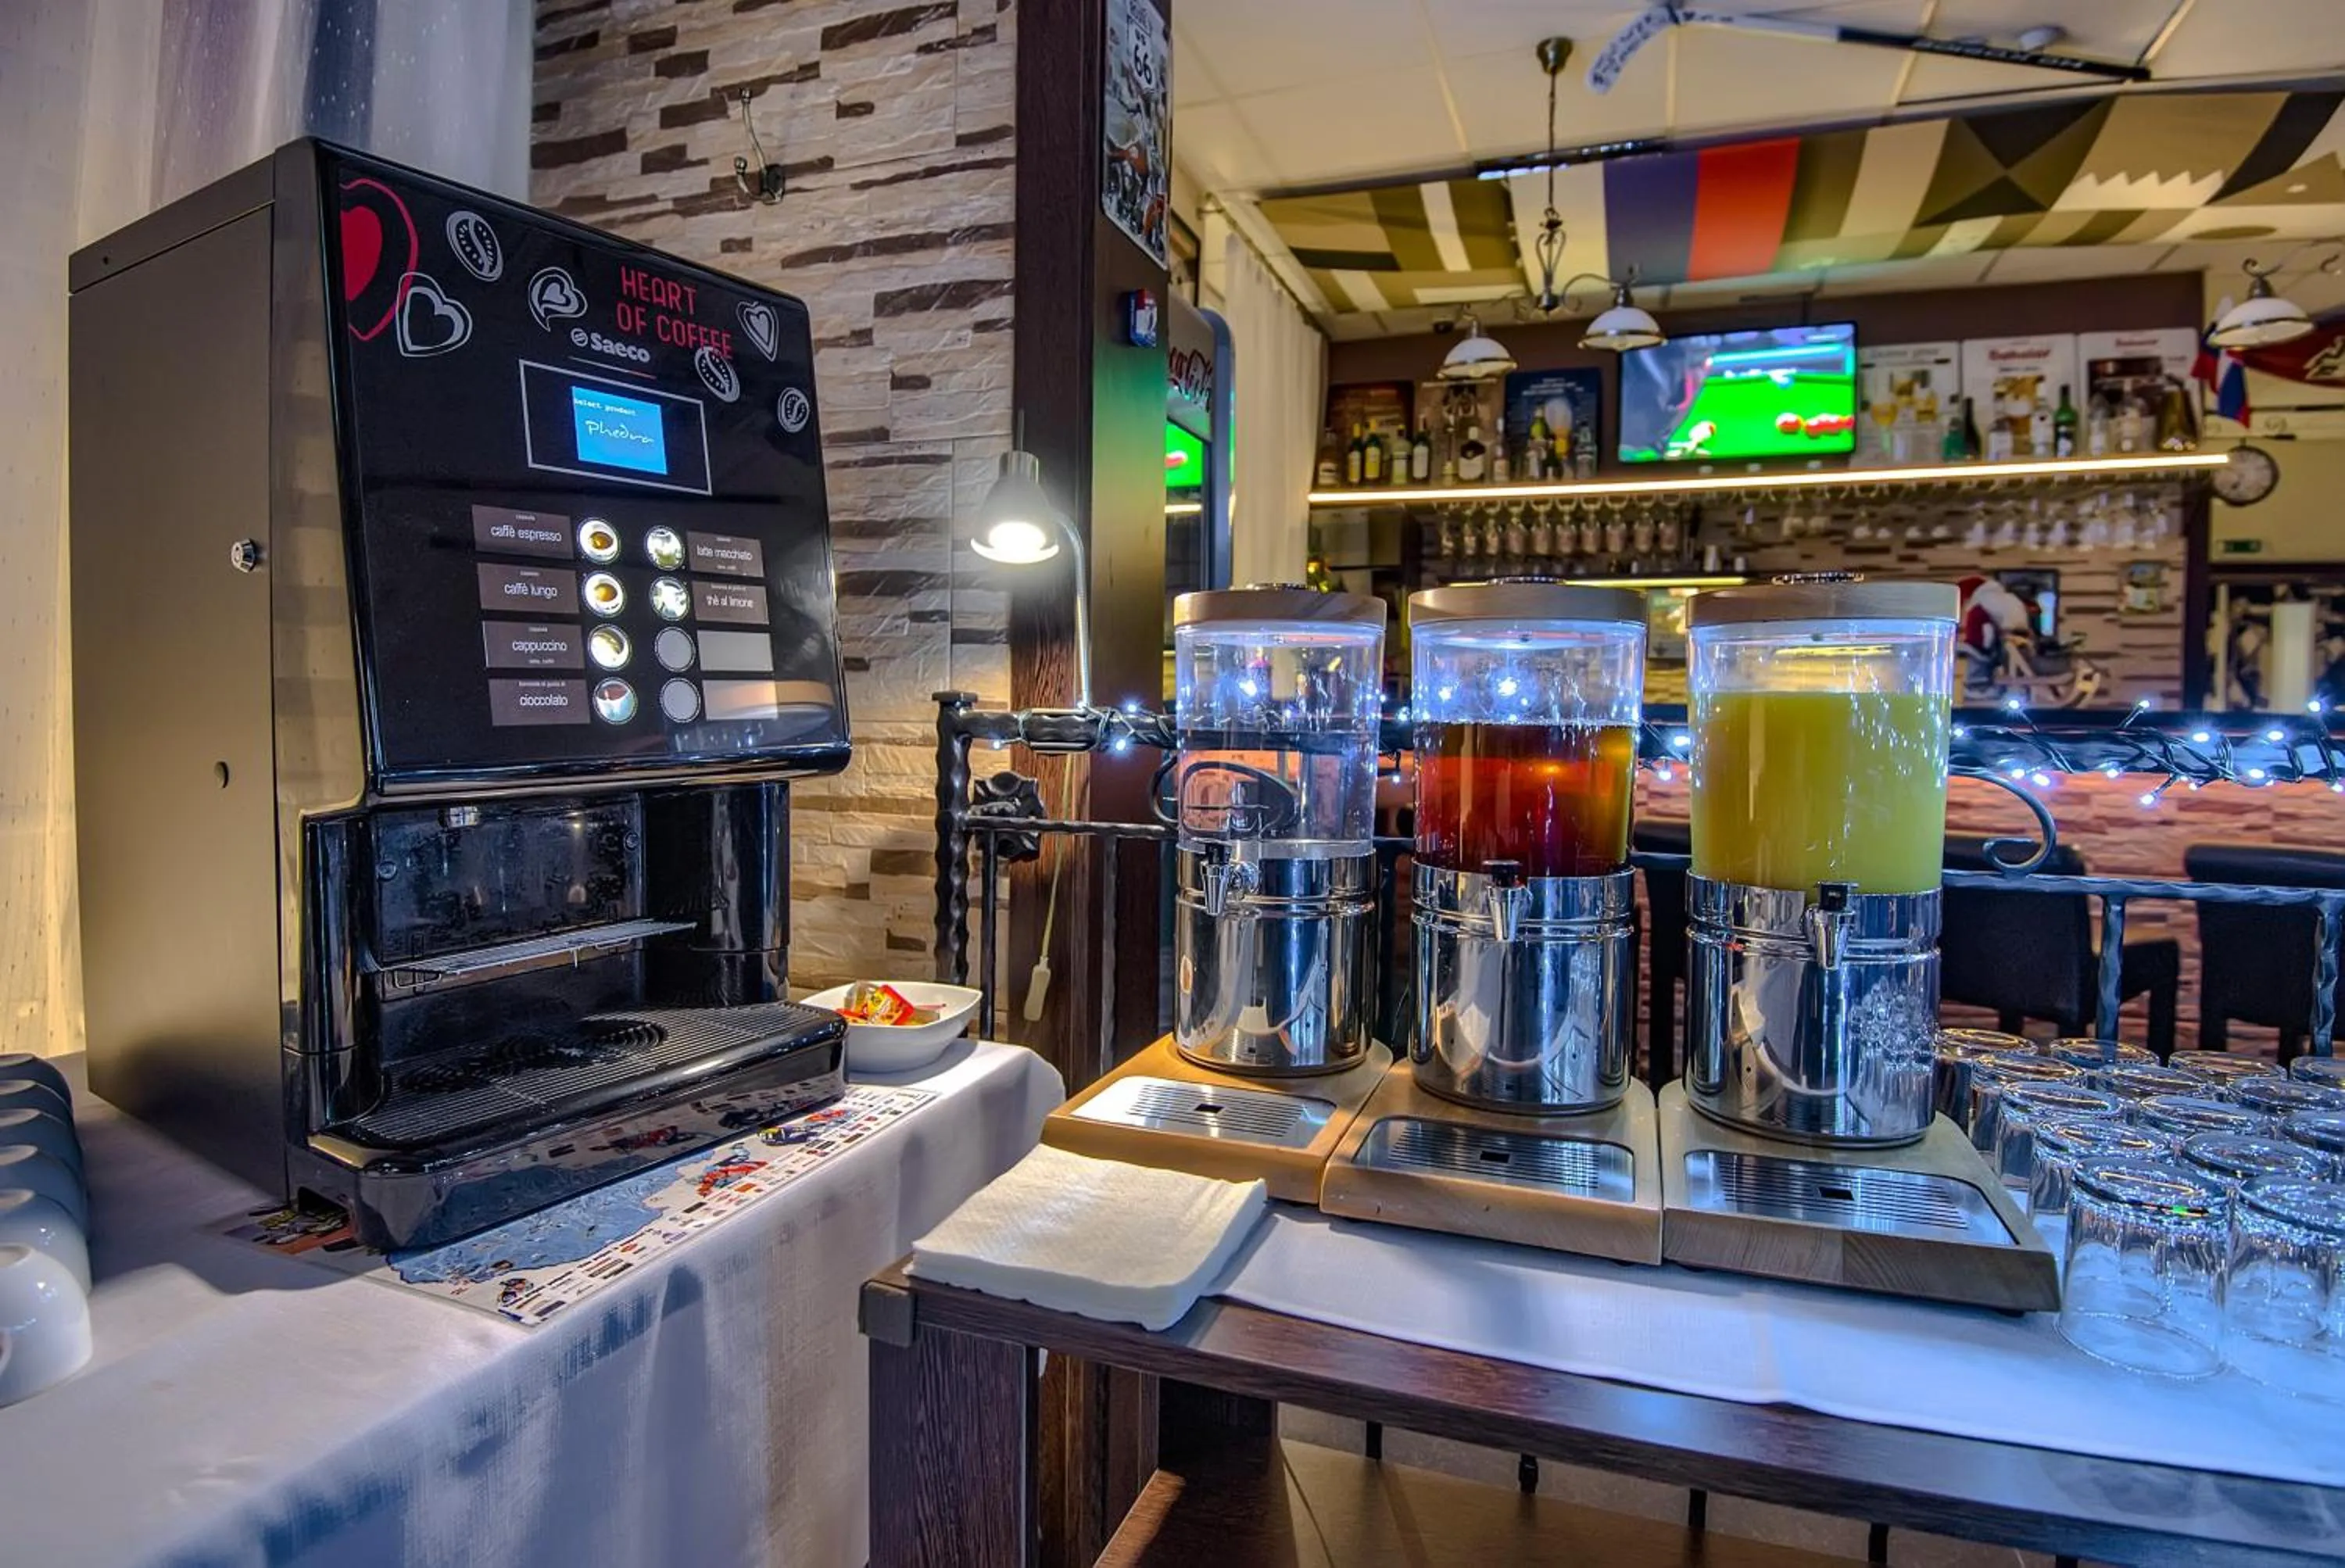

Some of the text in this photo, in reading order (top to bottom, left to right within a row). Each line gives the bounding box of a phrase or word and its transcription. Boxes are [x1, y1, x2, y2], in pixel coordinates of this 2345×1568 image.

[1134, 44, 1153, 84] 66
[620, 265, 697, 315] HEART
[616, 302, 734, 360] OF COFFEE
[589, 332, 651, 363] Saeco
[490, 524, 562, 542] caffè espresso
[503, 582, 558, 600] caffè lungo
[511, 639, 568, 654] cappuccino
[519, 693, 568, 707] cioccolato
